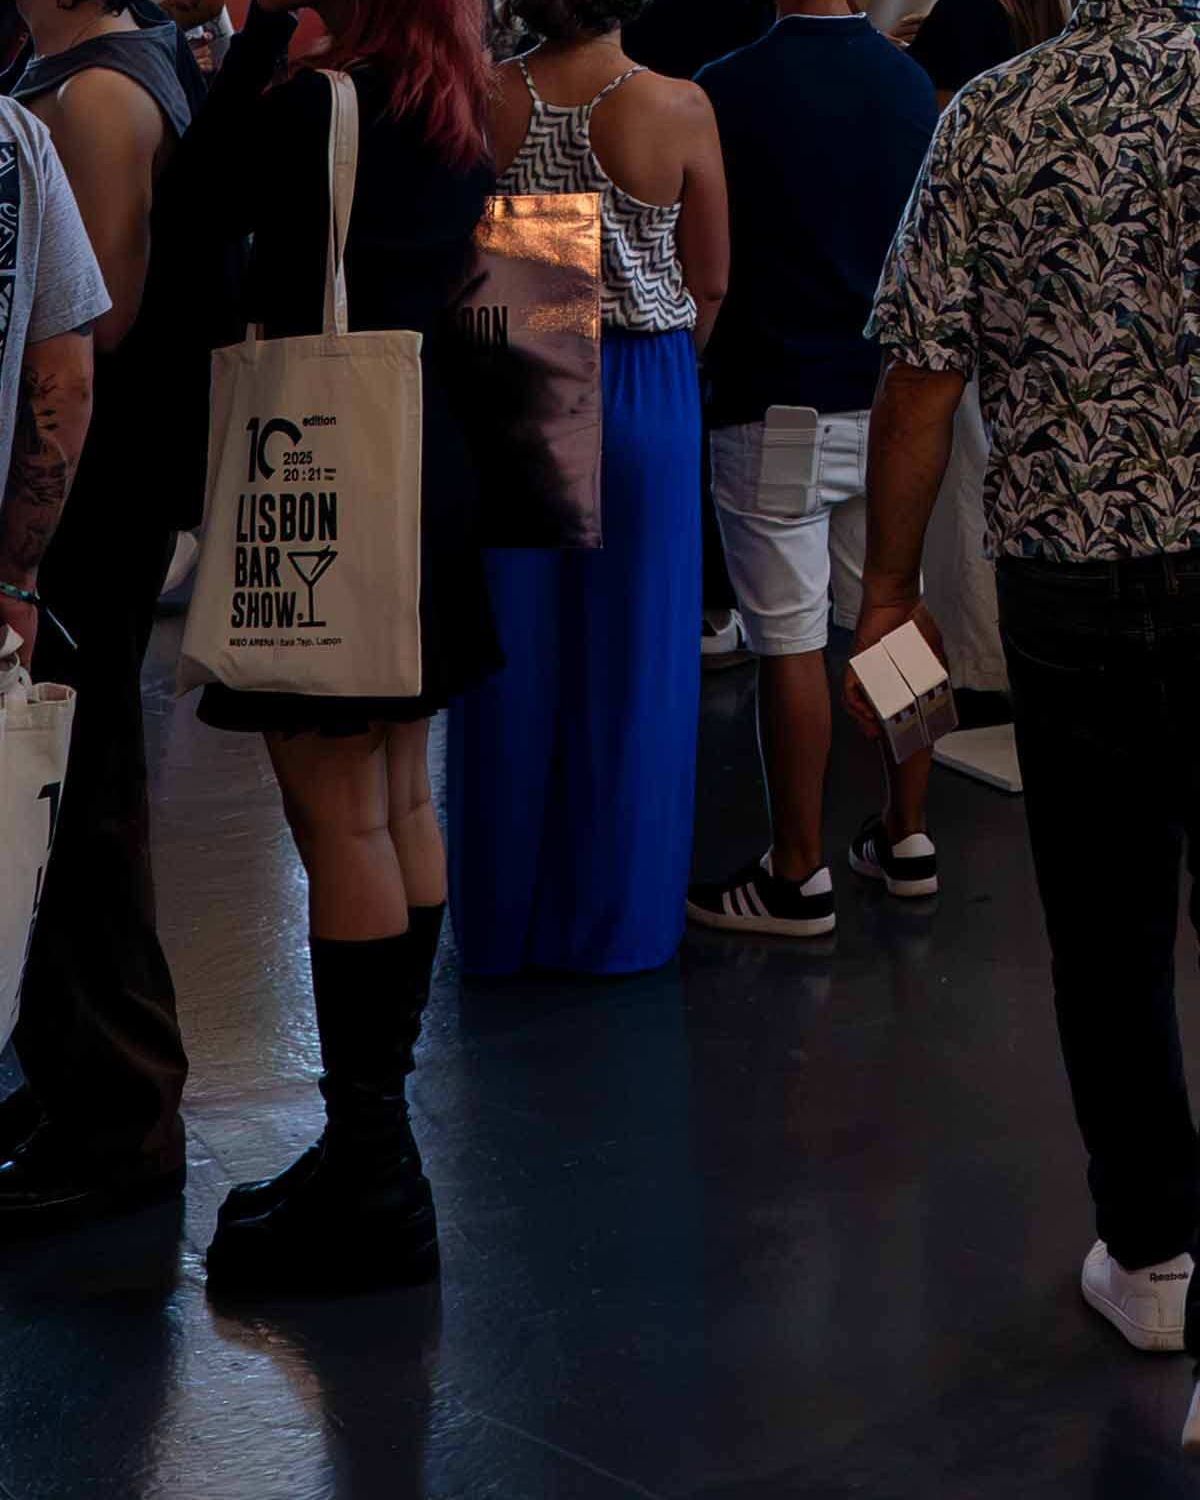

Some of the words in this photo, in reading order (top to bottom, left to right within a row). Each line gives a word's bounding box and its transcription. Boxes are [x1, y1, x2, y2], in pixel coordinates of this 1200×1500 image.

[302, 414, 337, 427] edition
[283, 451, 313, 466] 2025
[236, 491, 338, 543] LISBON
[234, 546, 282, 589] BAR
